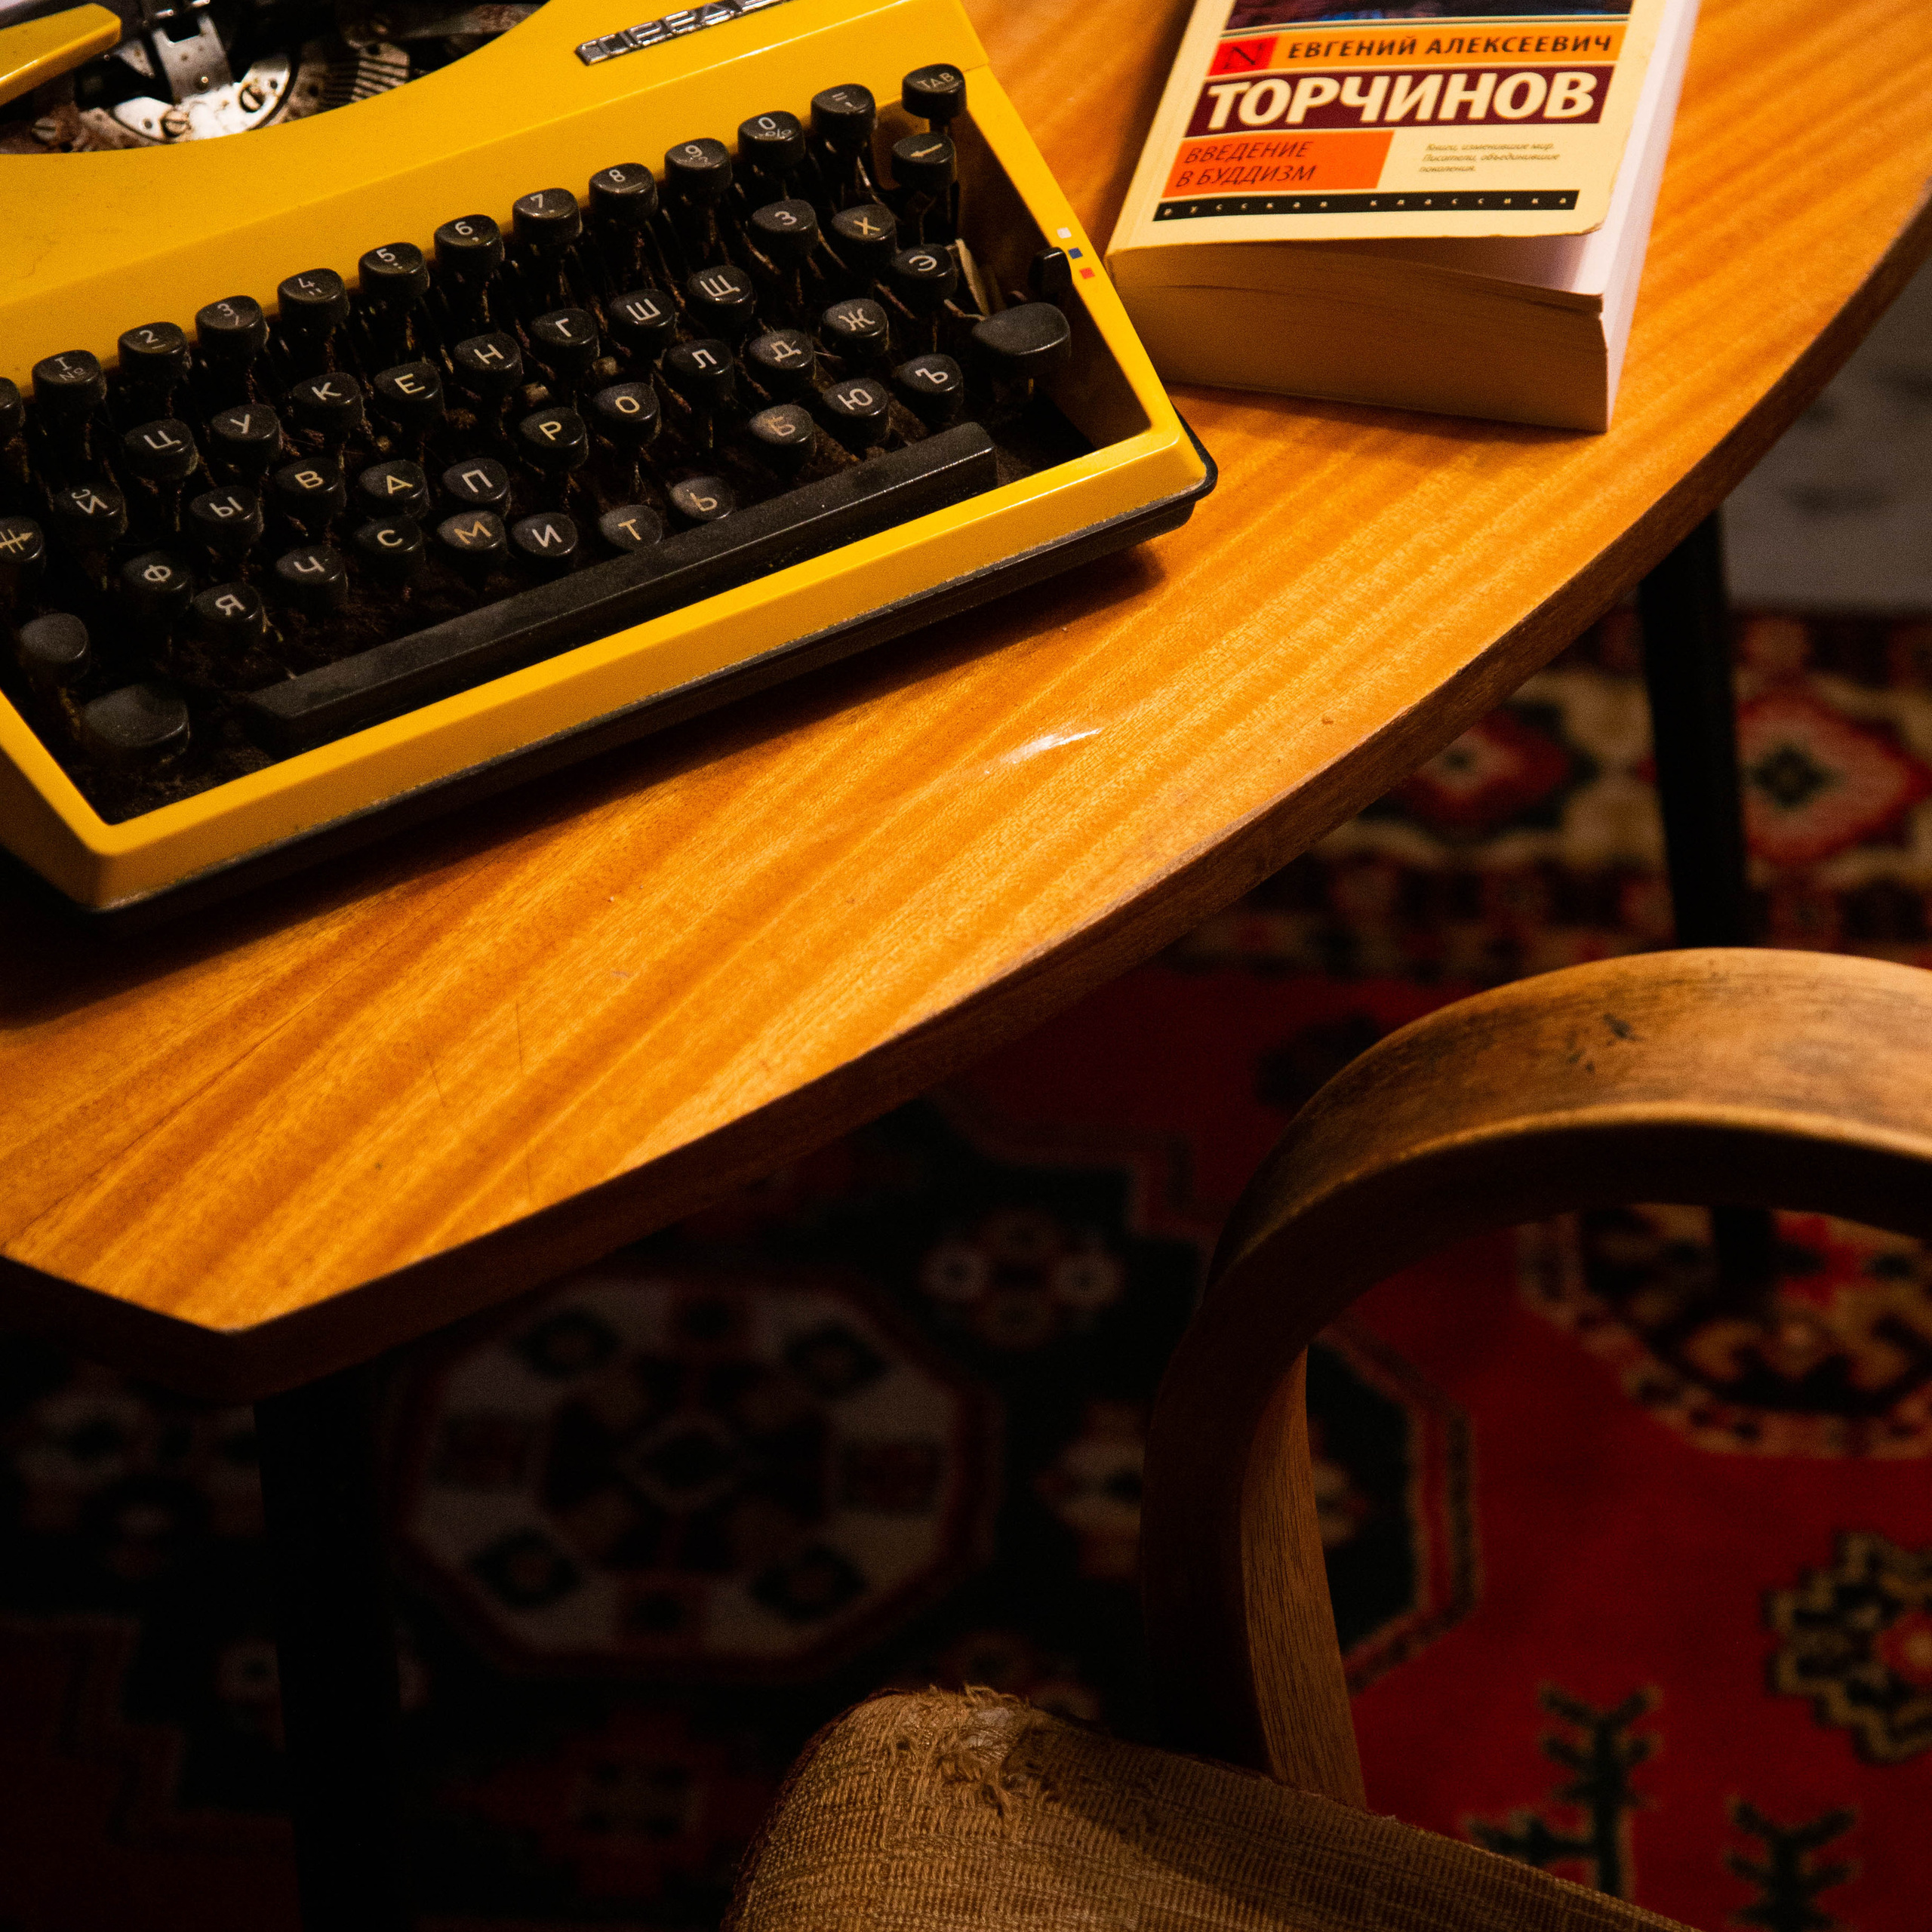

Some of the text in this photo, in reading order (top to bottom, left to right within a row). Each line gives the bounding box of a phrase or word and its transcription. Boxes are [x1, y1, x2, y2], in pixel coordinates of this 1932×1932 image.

[1287, 35, 1612, 59] ЕВГЕНИЙ АЛЕКСЕЕВИЧ
[1208, 71, 1598, 131] ТОРЧИНОВ
[685, 144, 703, 157] 9
[1184, 141, 1314, 164] ВВЕДЕНИЕ
[608, 169, 626, 182] 8
[1175, 165, 1318, 187] В БУДДИЗМ
[530, 193, 543, 208] 7
[454, 221, 473, 235] 6
[853, 217, 881, 235] Х
[376, 248, 395, 263] 5
[909, 254, 938, 272] Э
[700, 275, 741, 297] Щ
[217, 303, 234, 317] 3
[626, 298, 661, 321] Ш
[838, 307, 875, 331] Ж
[139, 330, 158, 344] 2
[555, 318, 572, 337] Г
[474, 343, 505, 365] Н
[692, 349, 718, 368] Л
[769, 339, 801, 361] Д
[395, 374, 426, 394] Е
[914, 367, 949, 385] Ъ
[311, 382, 342, 401] К
[837, 387, 874, 411] Ю
[615, 395, 641, 414] О
[230, 414, 251, 434] У
[539, 420, 562, 441] Р
[143, 430, 181, 450] Ц
[294, 470, 324, 489] В
[386, 475, 414, 494] А
[462, 469, 494, 494] П
[71, 489, 108, 514] Й
[209, 496, 244, 518] Ы
[377, 529, 403, 547] С
[454, 521, 492, 544] М
[531, 524, 563, 548] И
[617, 518, 642, 541] Т
[143, 564, 172, 583] Ф
[294, 555, 325, 573] Ч
[214, 593, 246, 617] Я
